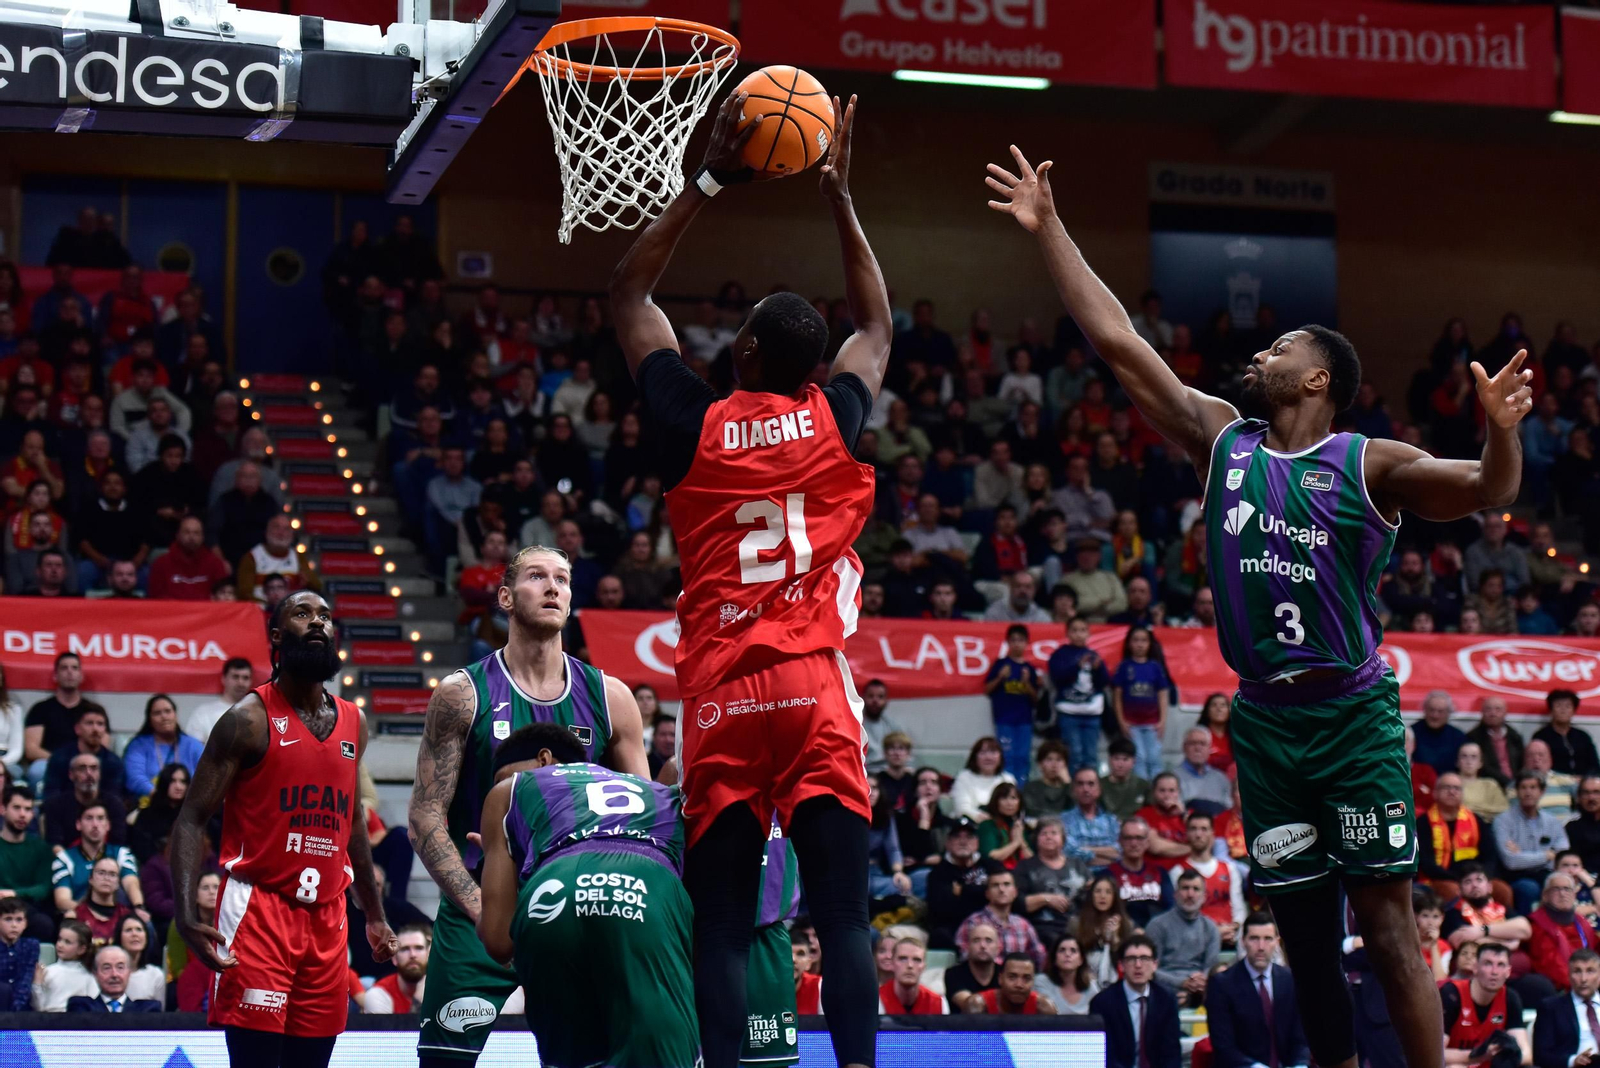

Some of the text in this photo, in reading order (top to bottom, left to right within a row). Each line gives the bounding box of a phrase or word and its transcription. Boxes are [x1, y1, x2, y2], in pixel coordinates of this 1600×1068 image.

[840, 31, 1063, 69] Grupo Helvetia
[1261, 14, 1527, 70] patrimonial
[0, 36, 286, 112] ndesa
[724, 409, 814, 450] DIAGNE
[734, 493, 813, 584] 21
[1259, 513, 1329, 549] Uncaja
[1239, 550, 1316, 583] málaga
[1274, 602, 1305, 646] 3
[3, 630, 228, 661] DE MURCIA
[1481, 653, 1597, 682] Juver
[726, 704, 763, 716] REGIÓN
[778, 697, 818, 709] MURCIA
[280, 784, 349, 819] UCAM
[586, 780, 645, 816] 6
[1337, 805, 1357, 813] sabor
[1388, 807, 1402, 816] acb
[289, 813, 340, 833] MURCIA
[1344, 806, 1379, 827] má
[305, 835, 333, 845] CARAVACA
[1255, 828, 1315, 860] famadesa
[295, 867, 321, 904] 8
[575, 888, 647, 909] DEL SOL
[576, 873, 648, 895] COSTA
[575, 900, 644, 923] MÁLAGA
[442, 1000, 495, 1024] famadesa
[753, 1014, 779, 1030] má
[749, 1026, 780, 1043] laga
